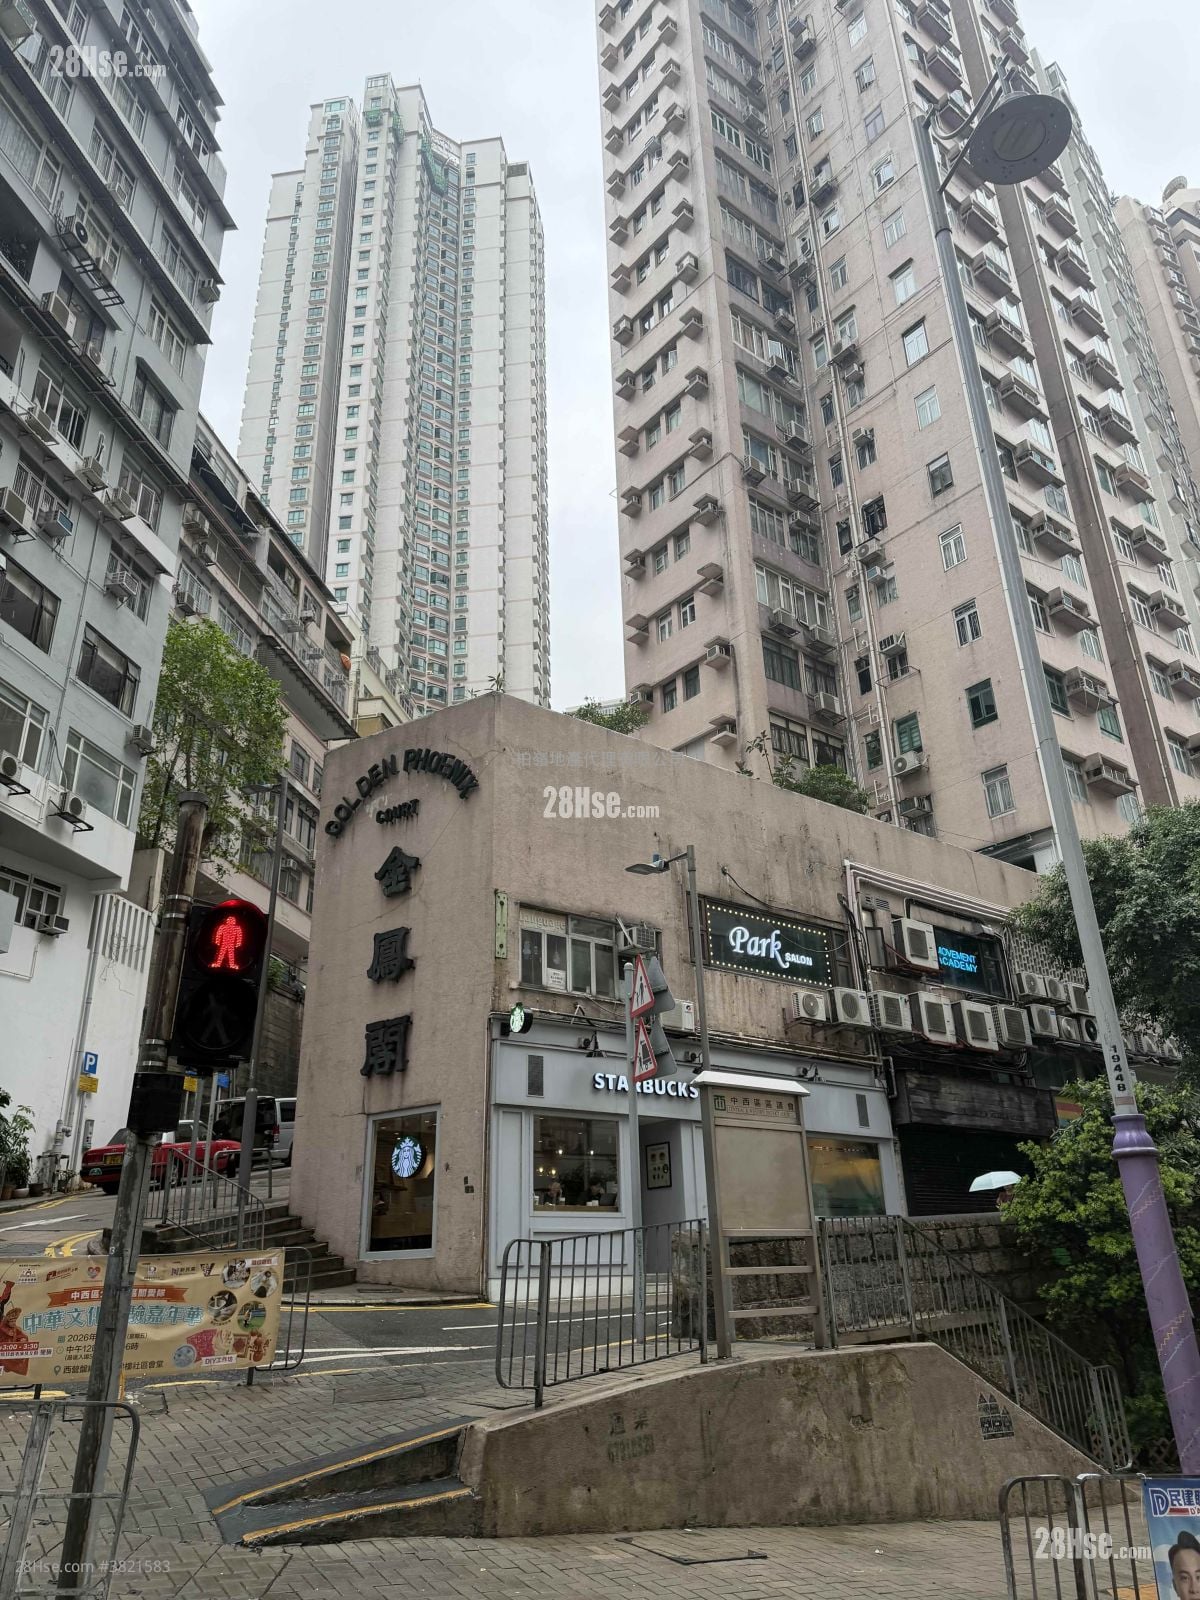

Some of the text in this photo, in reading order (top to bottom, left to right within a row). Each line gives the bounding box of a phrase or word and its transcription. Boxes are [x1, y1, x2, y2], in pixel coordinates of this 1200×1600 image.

[325, 748, 479, 837] GOLDEN PHOENIX
[376, 798, 420, 824] COURT
[360, 846, 421, 1078] 金鳳閣
[728, 926, 790, 969] Park
[784, 952, 813, 967] SALON
[86, 1054, 95, 1071] P
[1110, 1045, 1127, 1092] 19448
[71, 1290, 104, 1302] 中西區
